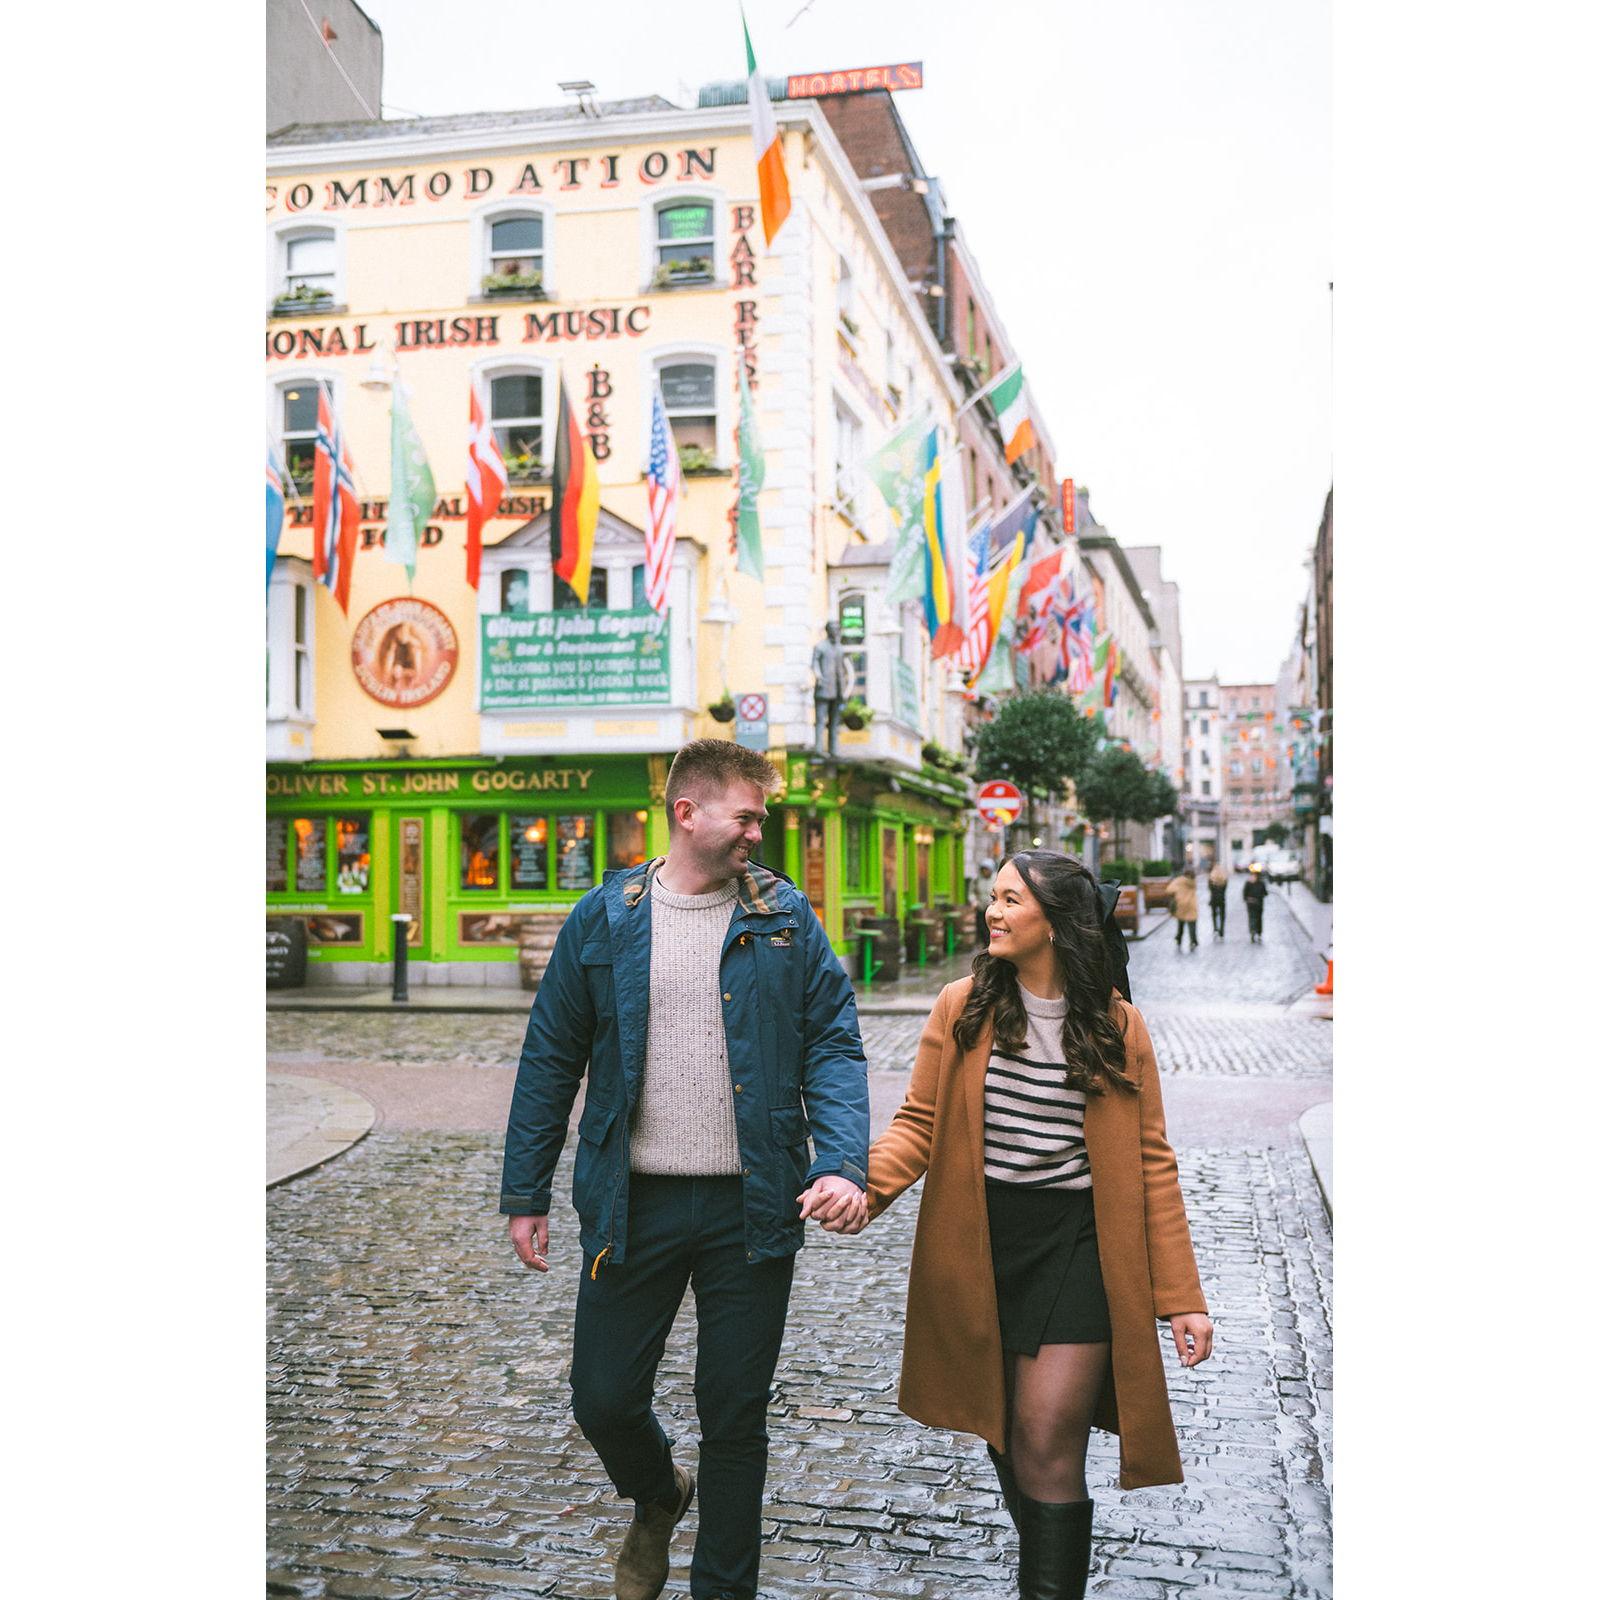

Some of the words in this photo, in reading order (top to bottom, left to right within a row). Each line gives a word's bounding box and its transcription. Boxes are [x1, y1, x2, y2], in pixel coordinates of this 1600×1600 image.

[732, 206, 757, 290] BAR
[396, 316, 499, 352] IRISH
[522, 306, 650, 343] MUSIC
[266, 773, 349, 796] OLIVER
[401, 771, 460, 793] JOHN
[471, 768, 594, 792] GOGARTY
